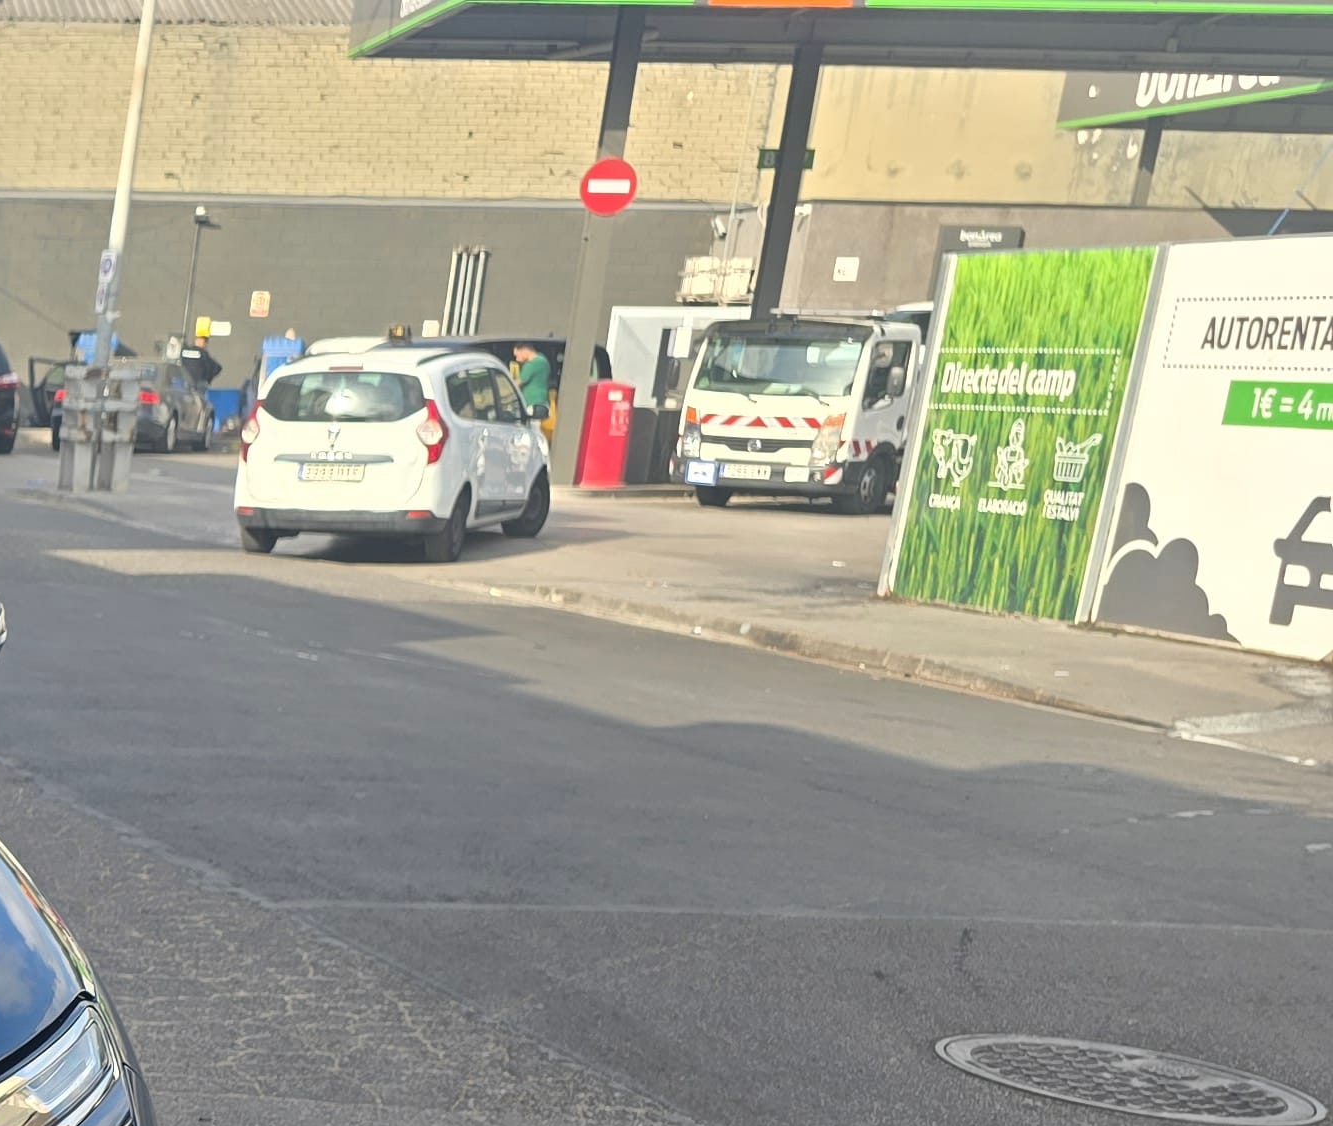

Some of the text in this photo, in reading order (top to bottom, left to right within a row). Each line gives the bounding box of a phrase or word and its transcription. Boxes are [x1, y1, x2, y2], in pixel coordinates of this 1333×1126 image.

[1200, 315, 1333, 350] AUTORENTA
[941, 361, 1076, 402] Directe del camp
[1251, 386, 1277, 419] 1€
[1297, 388, 1314, 421] 4
